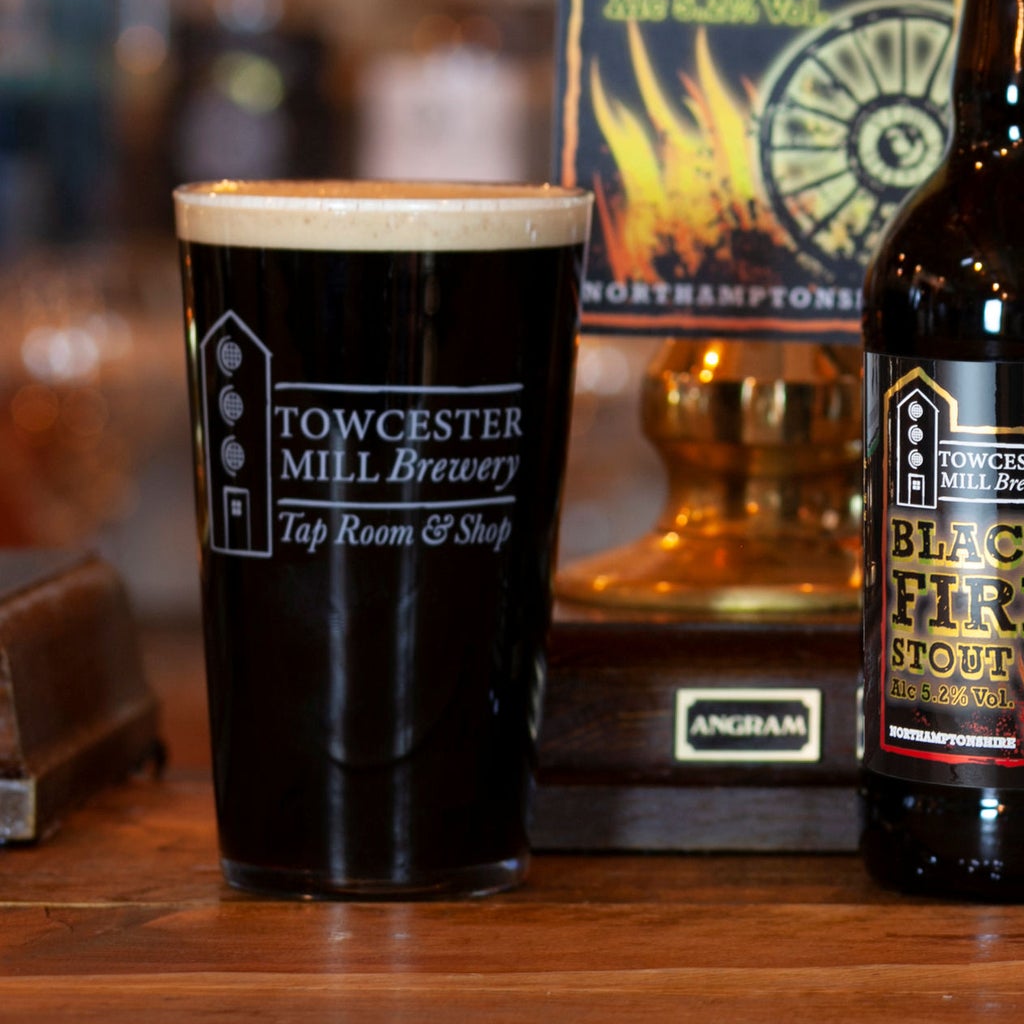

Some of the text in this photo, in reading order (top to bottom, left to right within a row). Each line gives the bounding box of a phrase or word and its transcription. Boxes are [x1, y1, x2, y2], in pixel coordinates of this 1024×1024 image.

[582, 280, 863, 310] NORTHAMPTONS
[274, 406, 524, 441] TOWCESTER
[280, 447, 520, 492] MILL Brewery
[940, 471, 994, 491] MILL
[278, 512, 512, 554] Tap Room & Shop
[889, 637, 1015, 682] STOUT
[889, 678, 1015, 710] Alc 5.2% Vol.
[689, 714, 807, 736] ANGRAM
[889, 724, 1017, 750] NORTHAMPTONSHIRE
